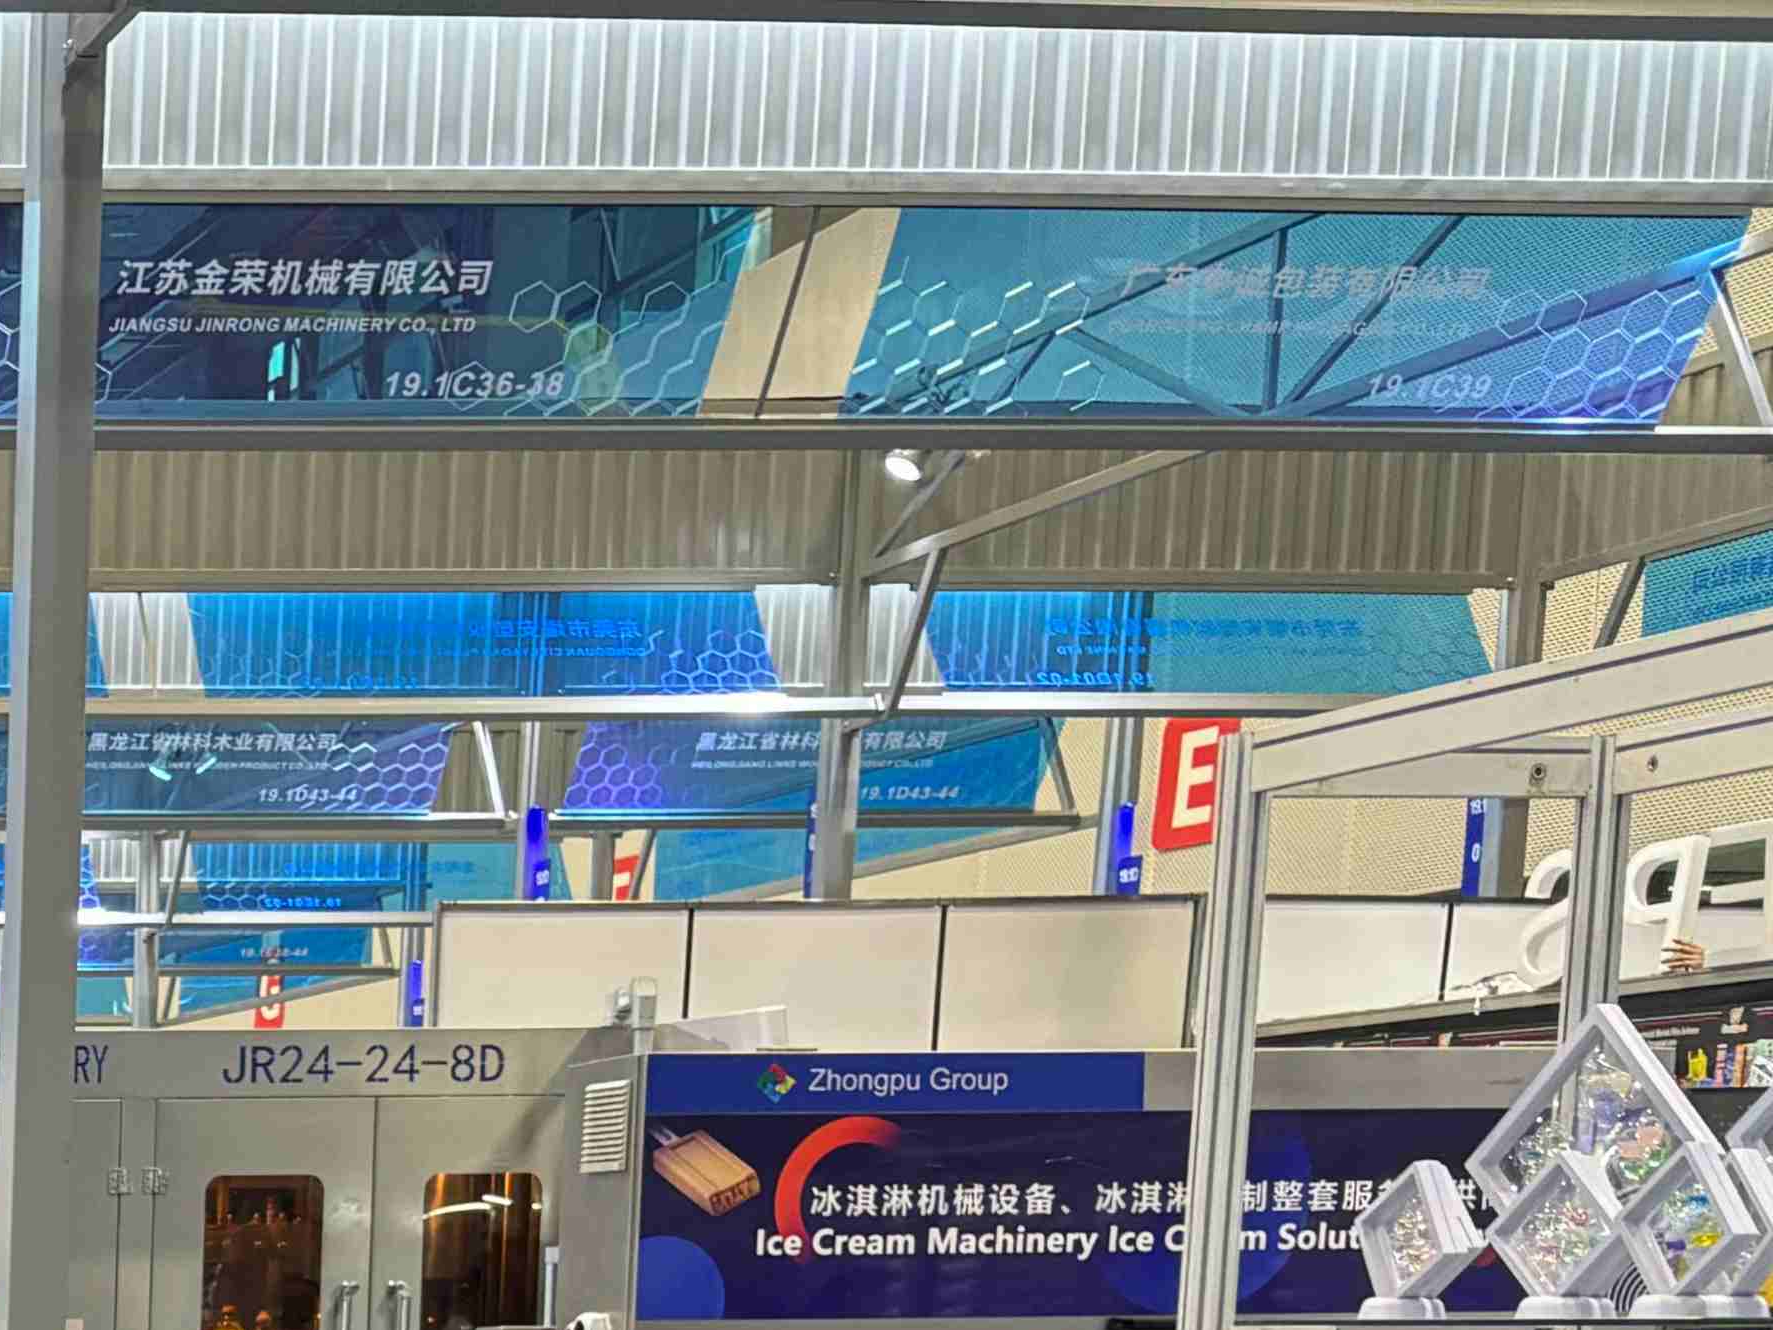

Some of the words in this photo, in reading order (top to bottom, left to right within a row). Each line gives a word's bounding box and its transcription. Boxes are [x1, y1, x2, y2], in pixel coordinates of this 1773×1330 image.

[116, 259, 493, 297] 江苏金荣机械有限公司
[108, 317, 192, 333] JIANGSU
[195, 317, 280, 333] JINRONG
[284, 317, 397, 333] MACHINERY
[438, 317, 476, 333] LTD
[385, 370, 565, 398] 19.1C36-38
[1368, 374, 1491, 400] 19.1C39
[1171, 725, 1220, 829] E
[223, 1043, 506, 1085] JR24-24-8D
[808, 1067, 922, 1095] Zhongpu
[930, 1068, 1009, 1095] Group
[756, 1230, 802, 1256] Ice
[812, 1229, 915, 1256] Cream
[928, 1226, 1098, 1260] Machinery
[1109, 1228, 1153, 1253] Ice
